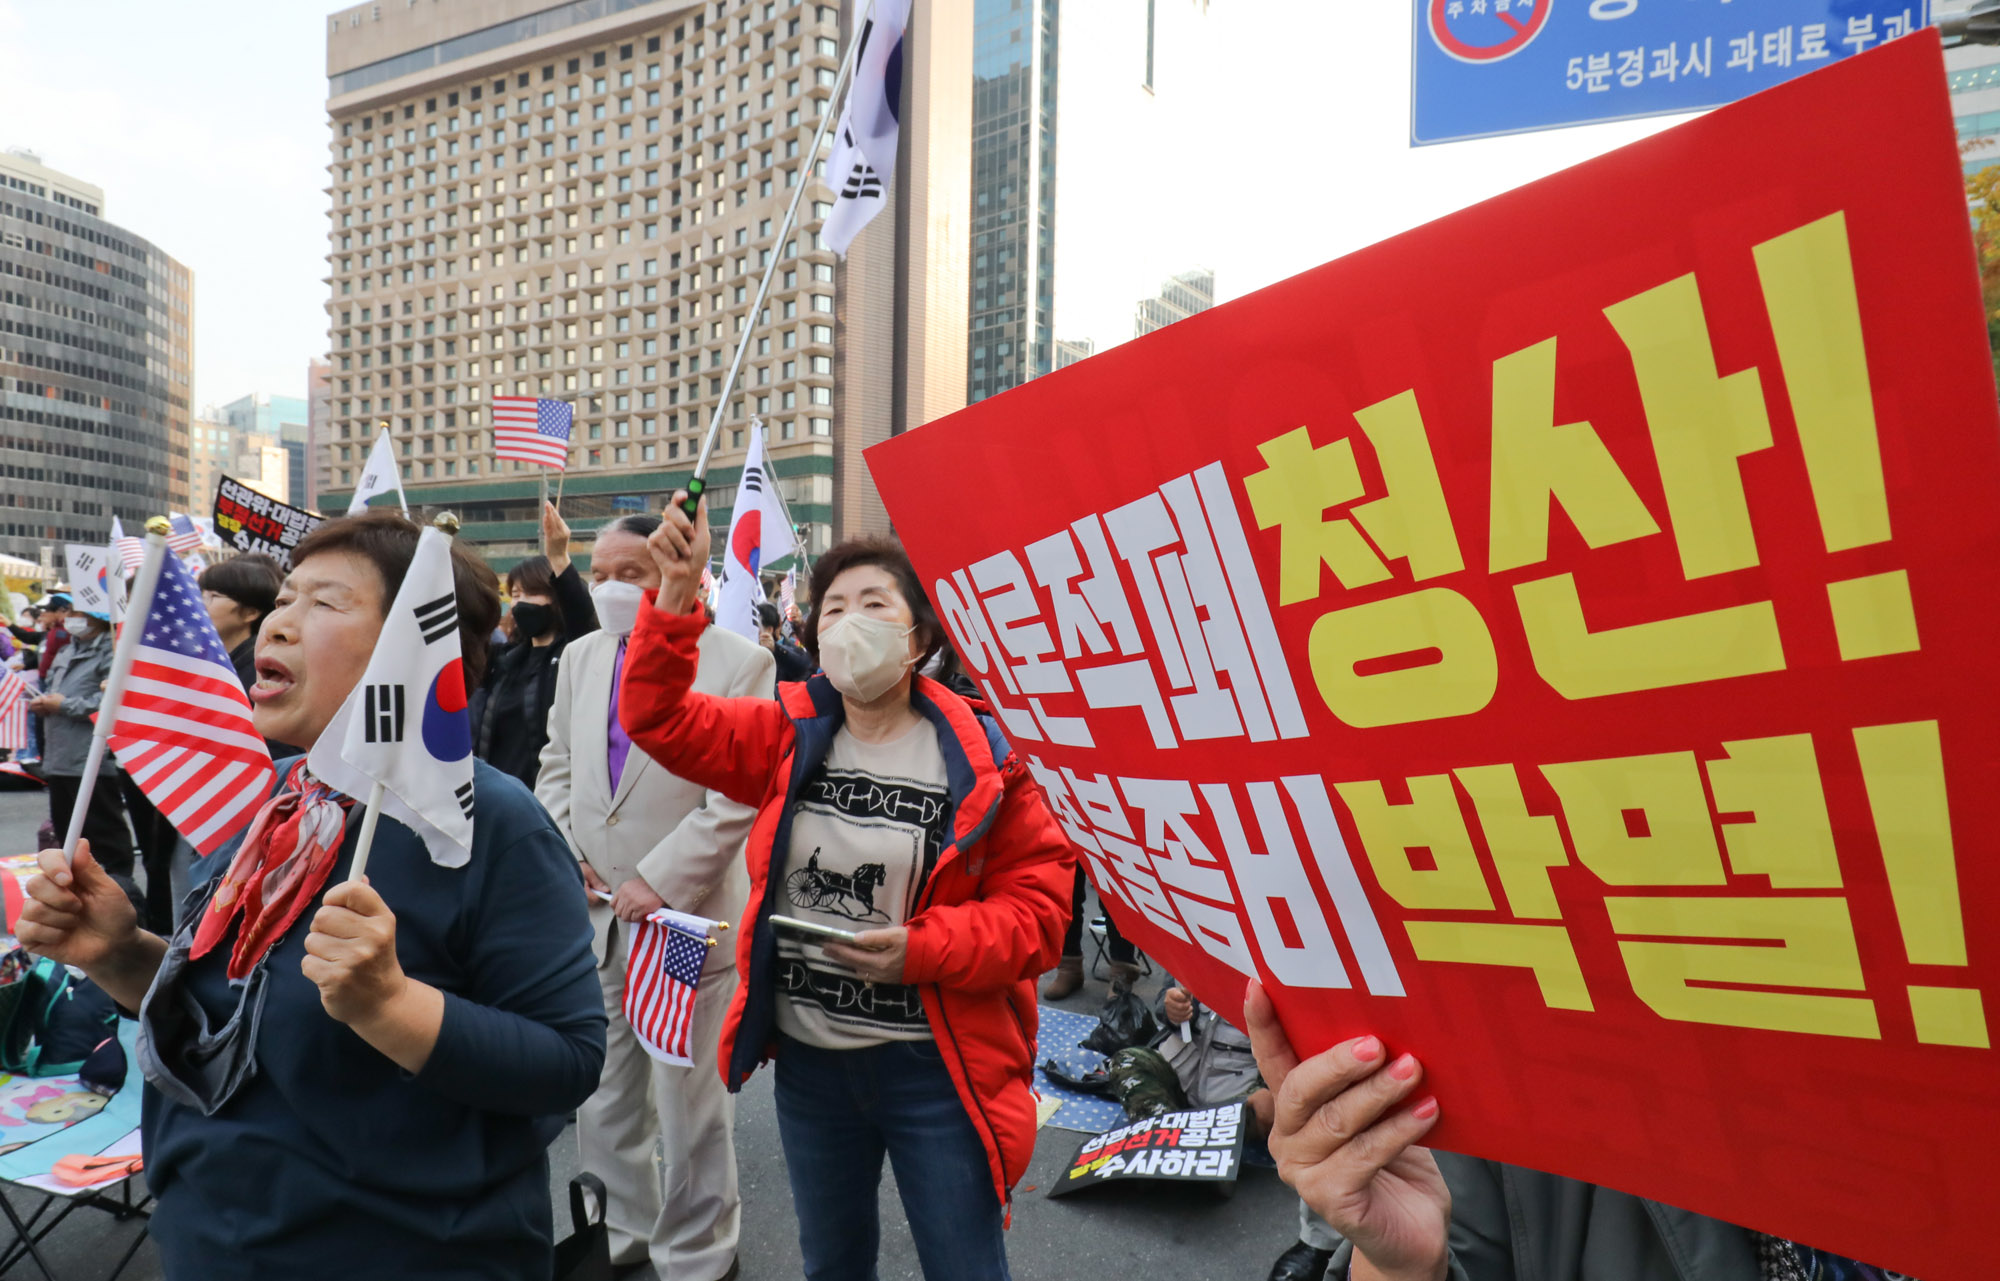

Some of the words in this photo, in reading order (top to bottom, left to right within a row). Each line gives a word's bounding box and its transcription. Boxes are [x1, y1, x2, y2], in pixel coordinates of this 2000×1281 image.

[1566, 36, 1712, 94] 5분경과시
[1726, 25, 1830, 72] 과태료
[1842, 8, 1915, 55] 부과
[935, 460, 1310, 749] 언론적폐
[1243, 210, 1921, 729] 청산!
[1026, 754, 1407, 996] 촛불좀비
[1333, 719, 1991, 1049] 박멸!
